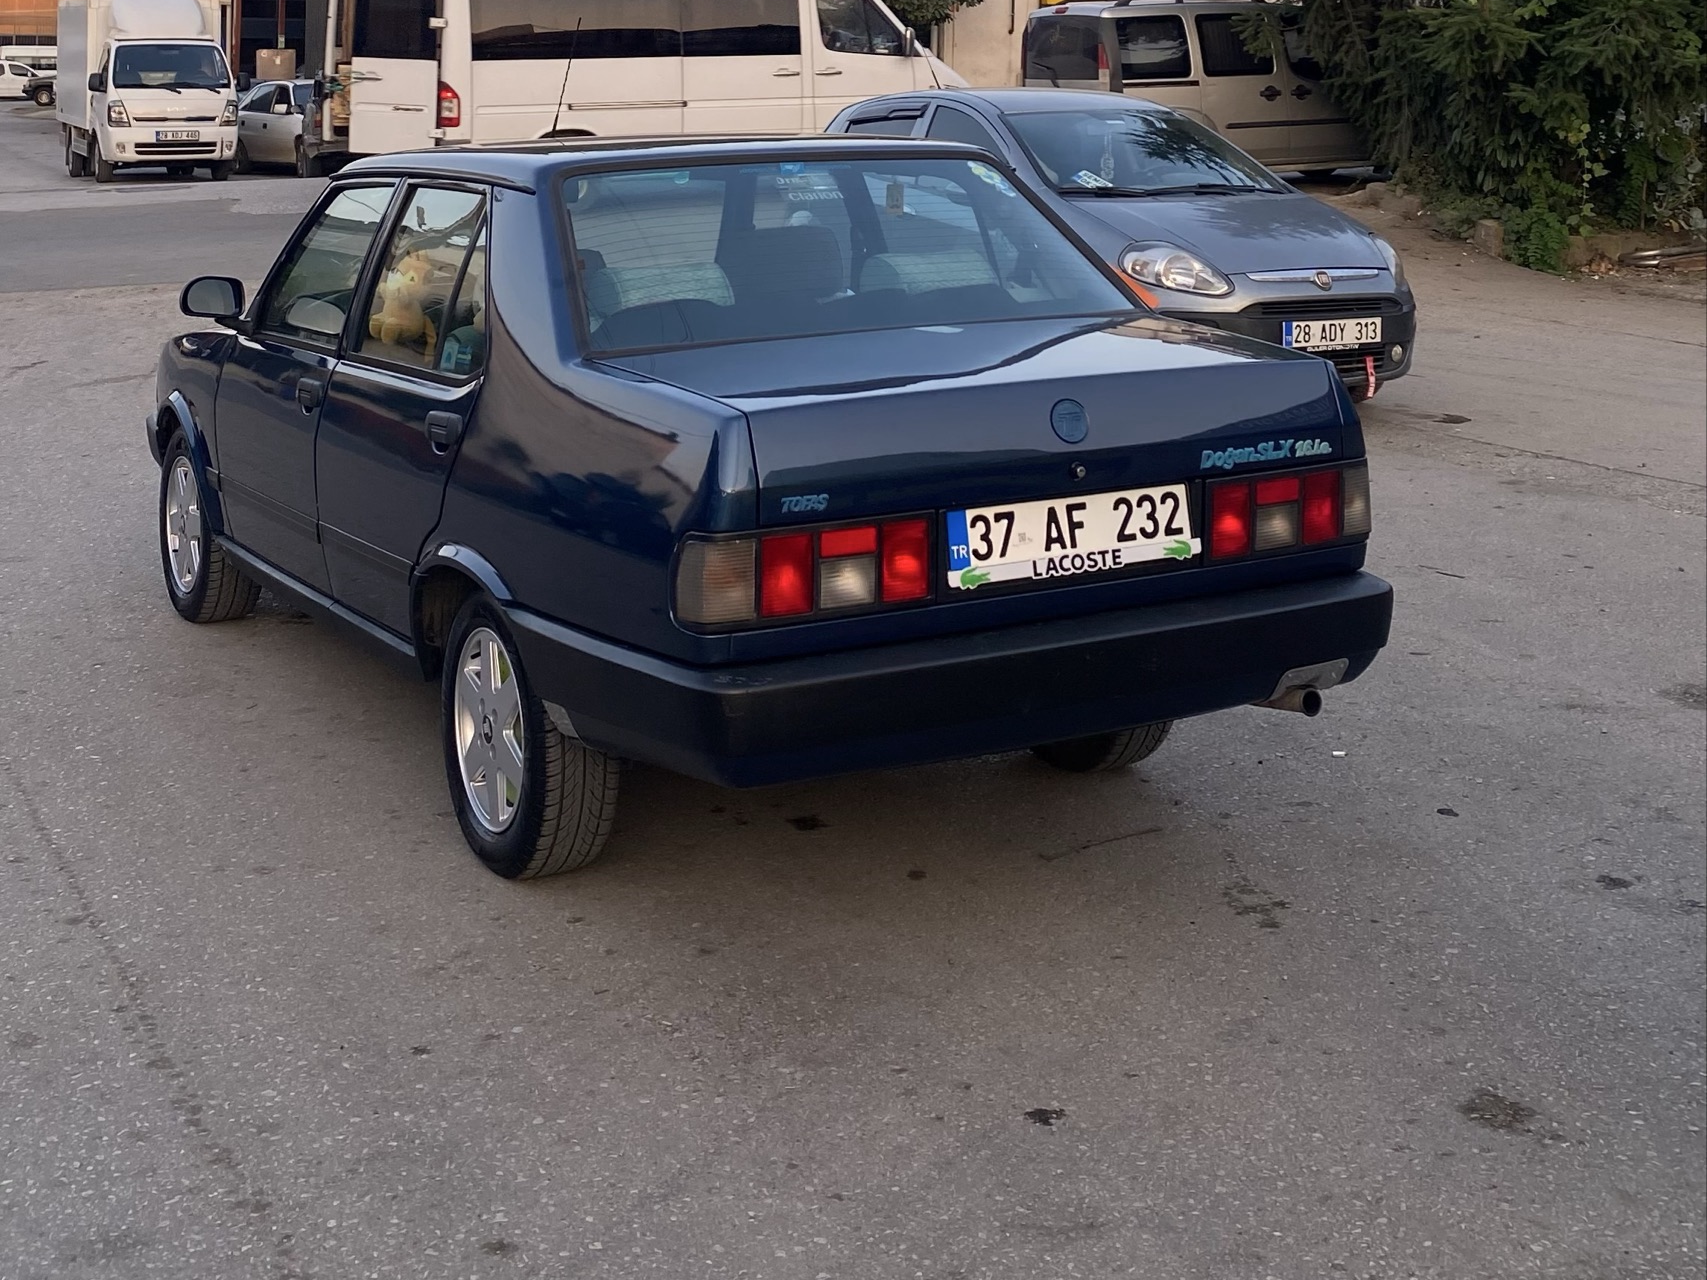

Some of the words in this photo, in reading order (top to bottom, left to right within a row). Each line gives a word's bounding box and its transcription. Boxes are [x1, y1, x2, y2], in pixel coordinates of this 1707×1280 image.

[788, 190, 844, 200] Clarion
[1294, 324, 1311, 343] 28
[1320, 322, 1346, 343] ADY
[1355, 321, 1378, 341] 313
[969, 510, 1015, 561] 37
[1044, 501, 1087, 552] AF
[1112, 491, 1184, 543] 232
[951, 545, 968, 560] TR
[1032, 548, 1123, 578] LACOSTE
